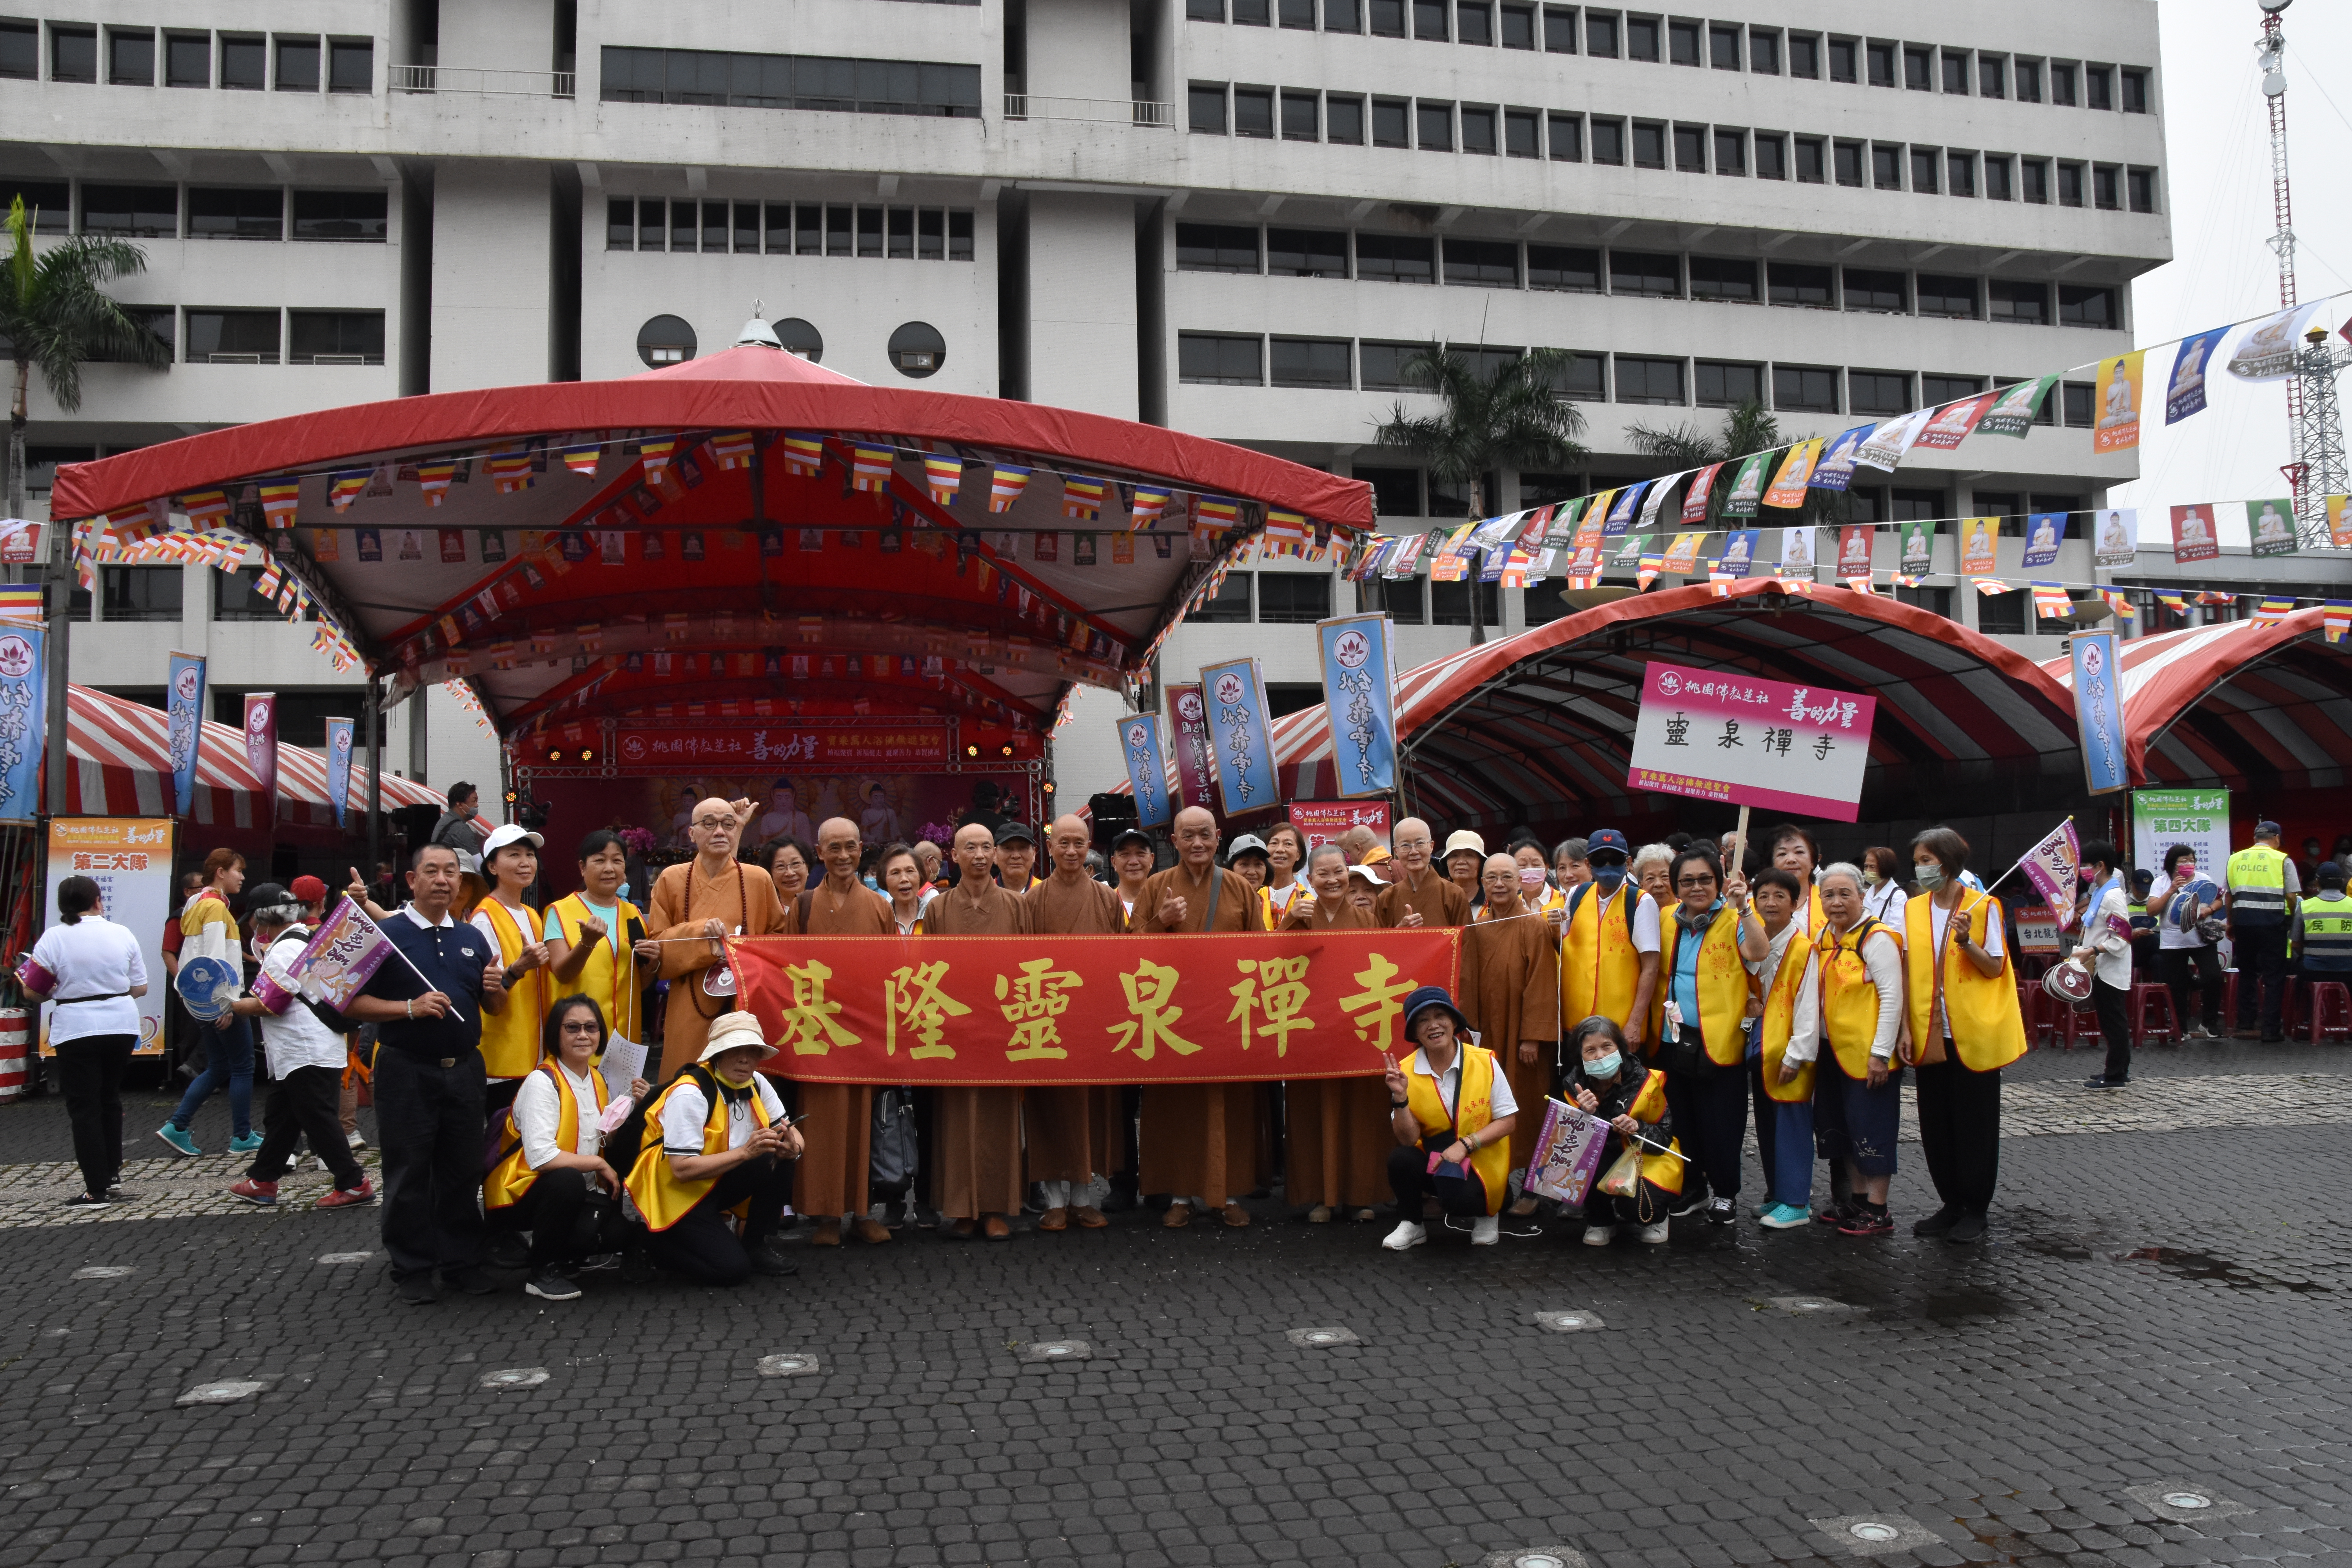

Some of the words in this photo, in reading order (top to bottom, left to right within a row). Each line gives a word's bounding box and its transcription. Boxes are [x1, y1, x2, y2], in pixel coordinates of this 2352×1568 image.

[1685, 679, 1768, 704] 桃園佛教蓮社
[1782, 689, 1858, 728] 善的力量
[1664, 711, 1835, 760] 靈泉禪寺
[652, 738, 741, 758] 桃園佛教蓮社
[746, 731, 819, 760] 善的力量
[1641, 771, 1730, 793] 寶乘萬人浴佛無遮聖會
[2190, 796, 2223, 810] 善的力量
[1306, 809, 1346, 818] 桃園佛教蓮社
[1349, 809, 1384, 825] 善的力量
[2152, 818, 2211, 833] 第四大隊
[122, 826, 165, 844] 善的力量
[73, 852, 149, 871] 第二大隊
[2040, 836, 2075, 889] 善的力量
[2312, 920, 2352, 931] 民防
[1705, 942, 1732, 955] 靈泉禪寺
[1831, 959, 1857, 971] 靈泉禪寺
[776, 953, 1418, 1062] 基隆靈泉禪寺
